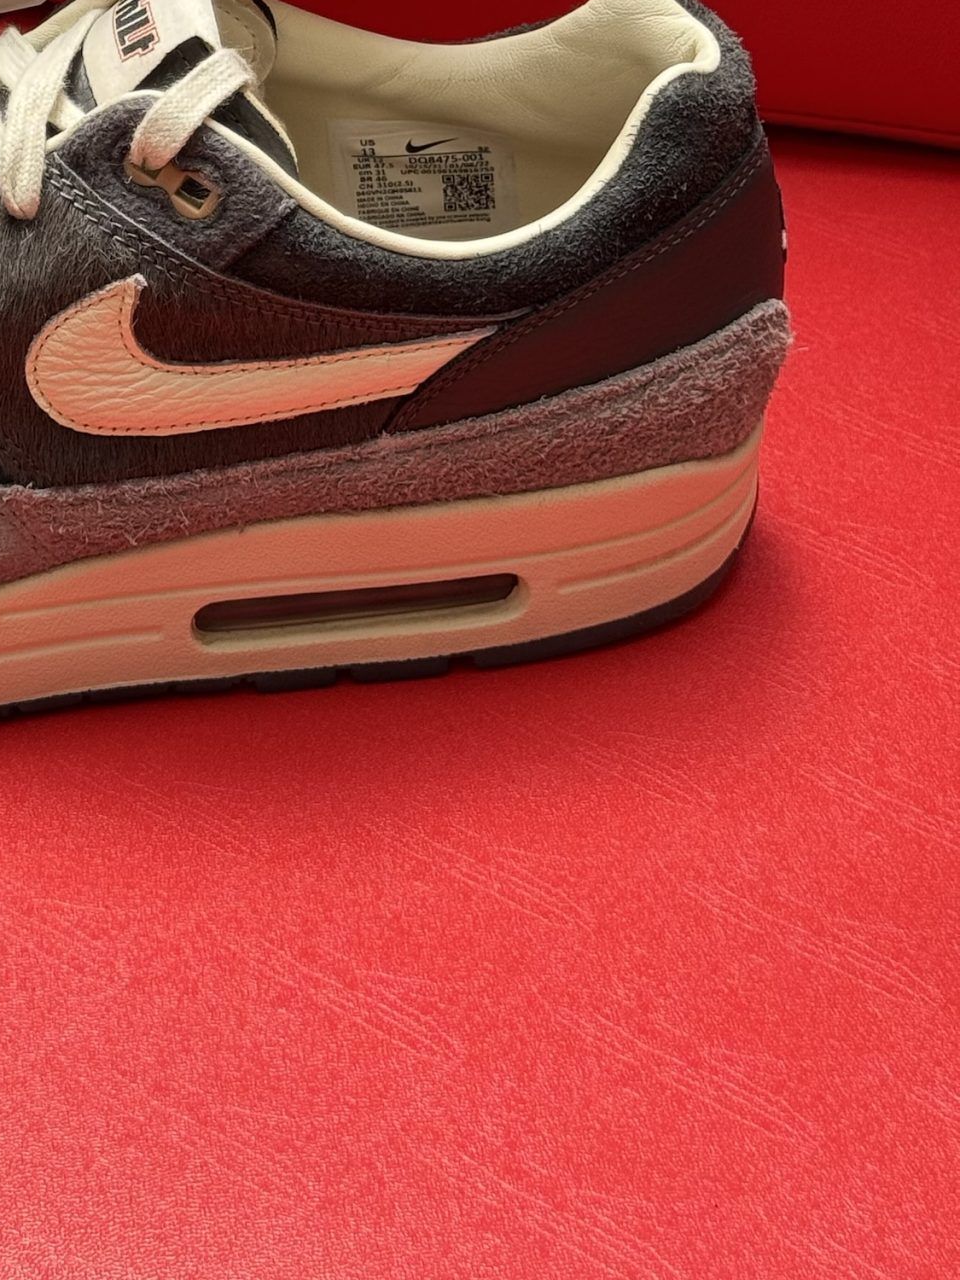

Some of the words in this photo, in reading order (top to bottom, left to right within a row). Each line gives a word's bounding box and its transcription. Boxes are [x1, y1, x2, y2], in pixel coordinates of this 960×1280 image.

[360, 139, 376, 147] US
[360, 148, 376, 157] 13
[409, 154, 484, 164] DQ8475-001
[376, 180, 414, 188] 310(2.5)
